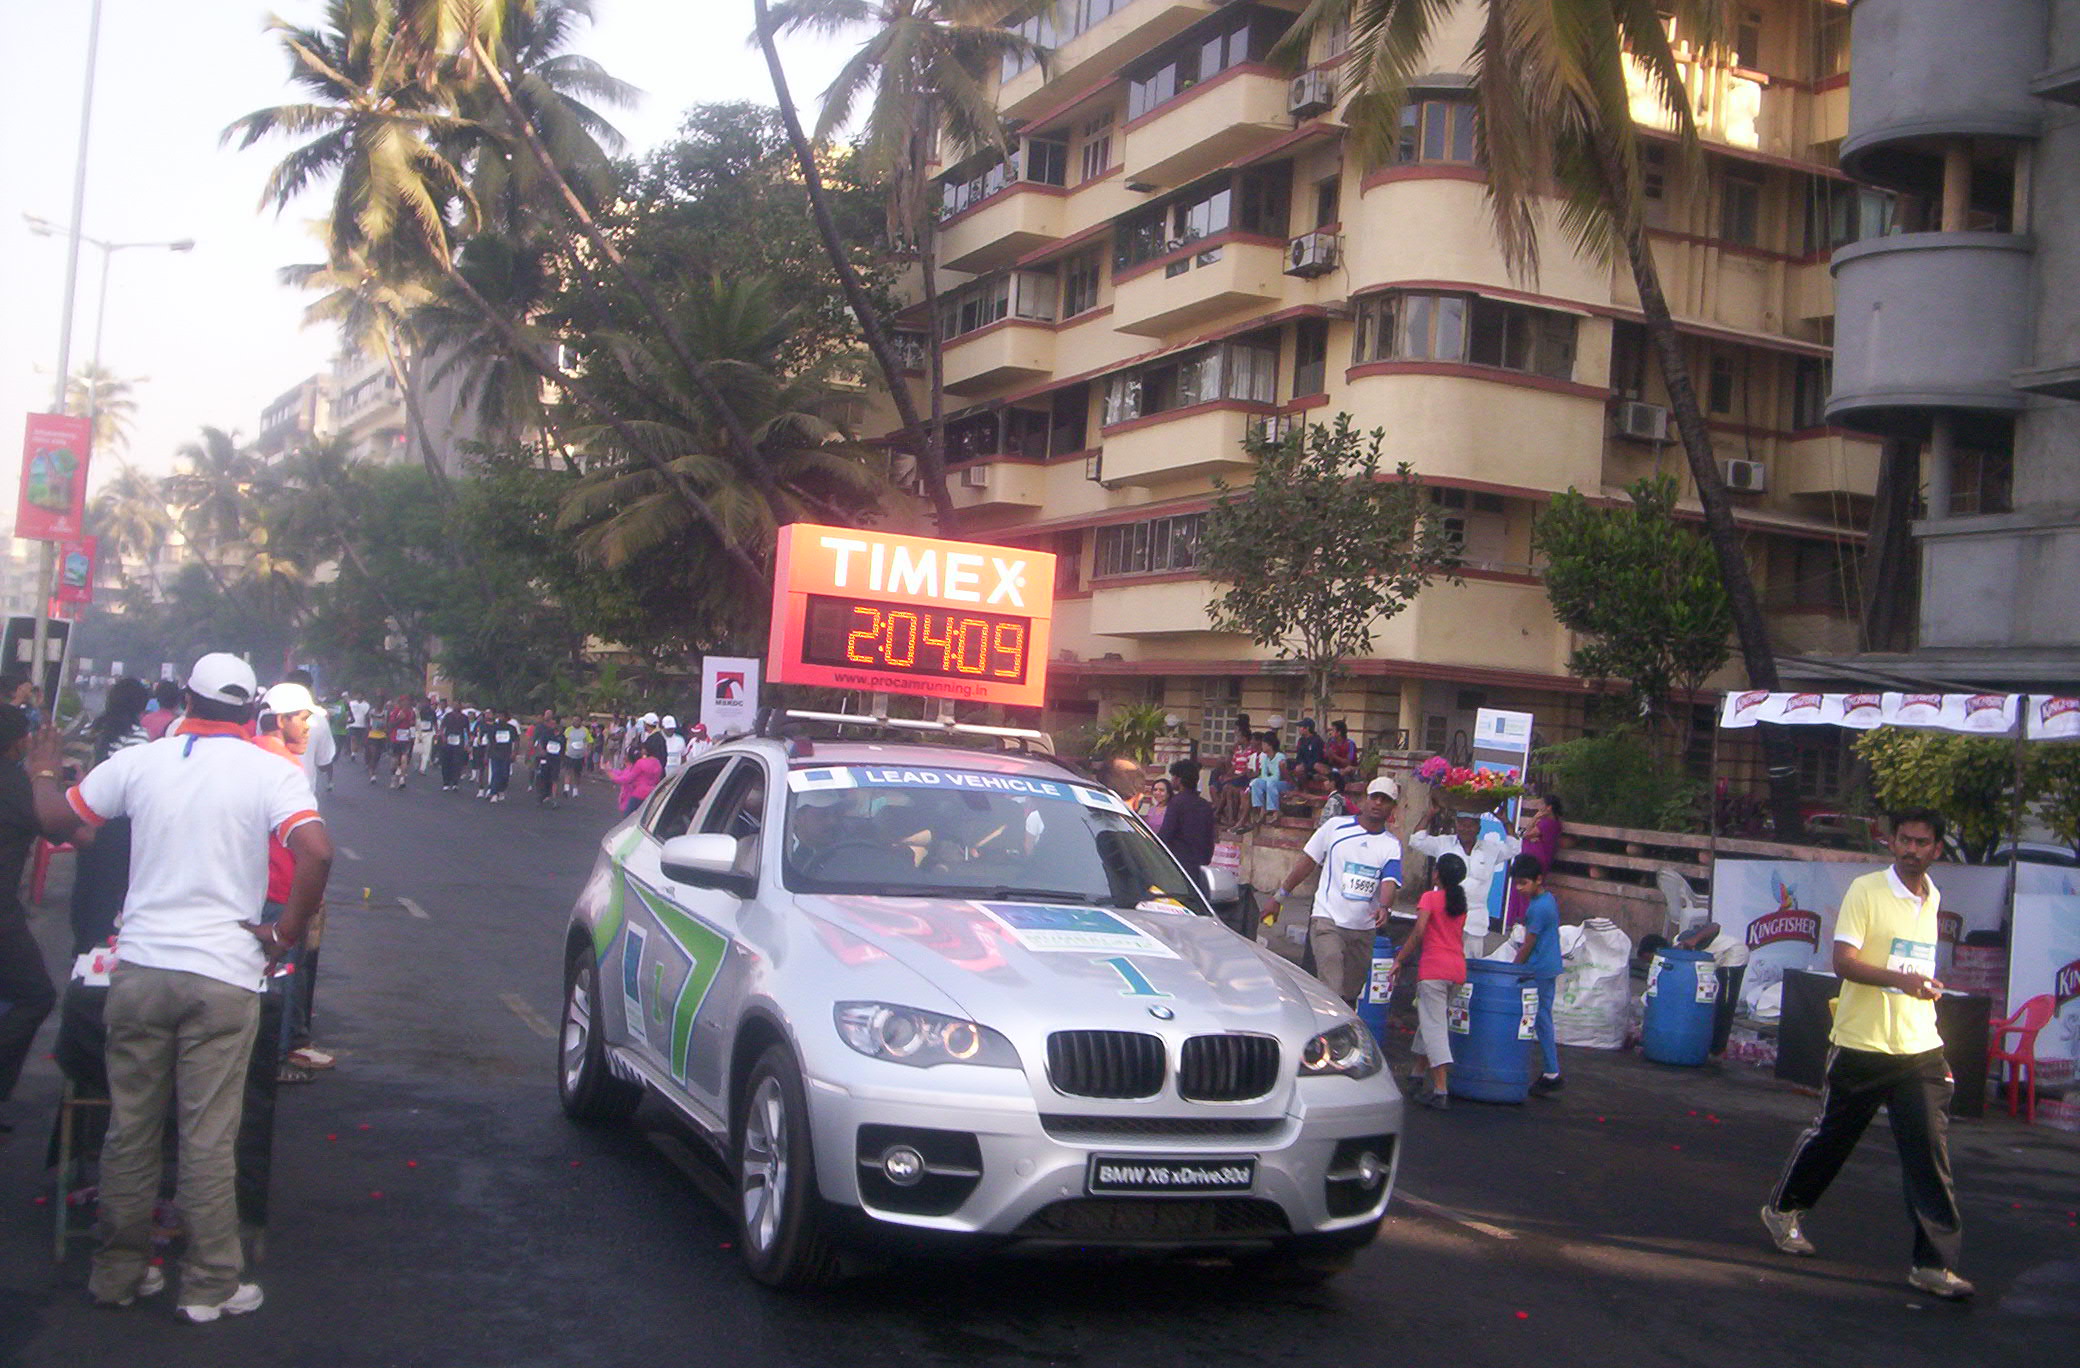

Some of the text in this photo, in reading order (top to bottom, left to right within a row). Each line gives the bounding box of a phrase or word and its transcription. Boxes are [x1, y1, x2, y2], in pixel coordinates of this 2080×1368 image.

[820, 536, 1027, 607] TIMEX
[847, 606, 1024, 678] 2:04:09
[834, 672, 988, 697] www.procamrunning.in
[867, 769, 1062, 797] LEAD VEHICLE
[1748, 917, 1816, 945] KINGFISHER
[1099, 1165, 1146, 1184] BMW
[1146, 1166, 1170, 1185] X6
